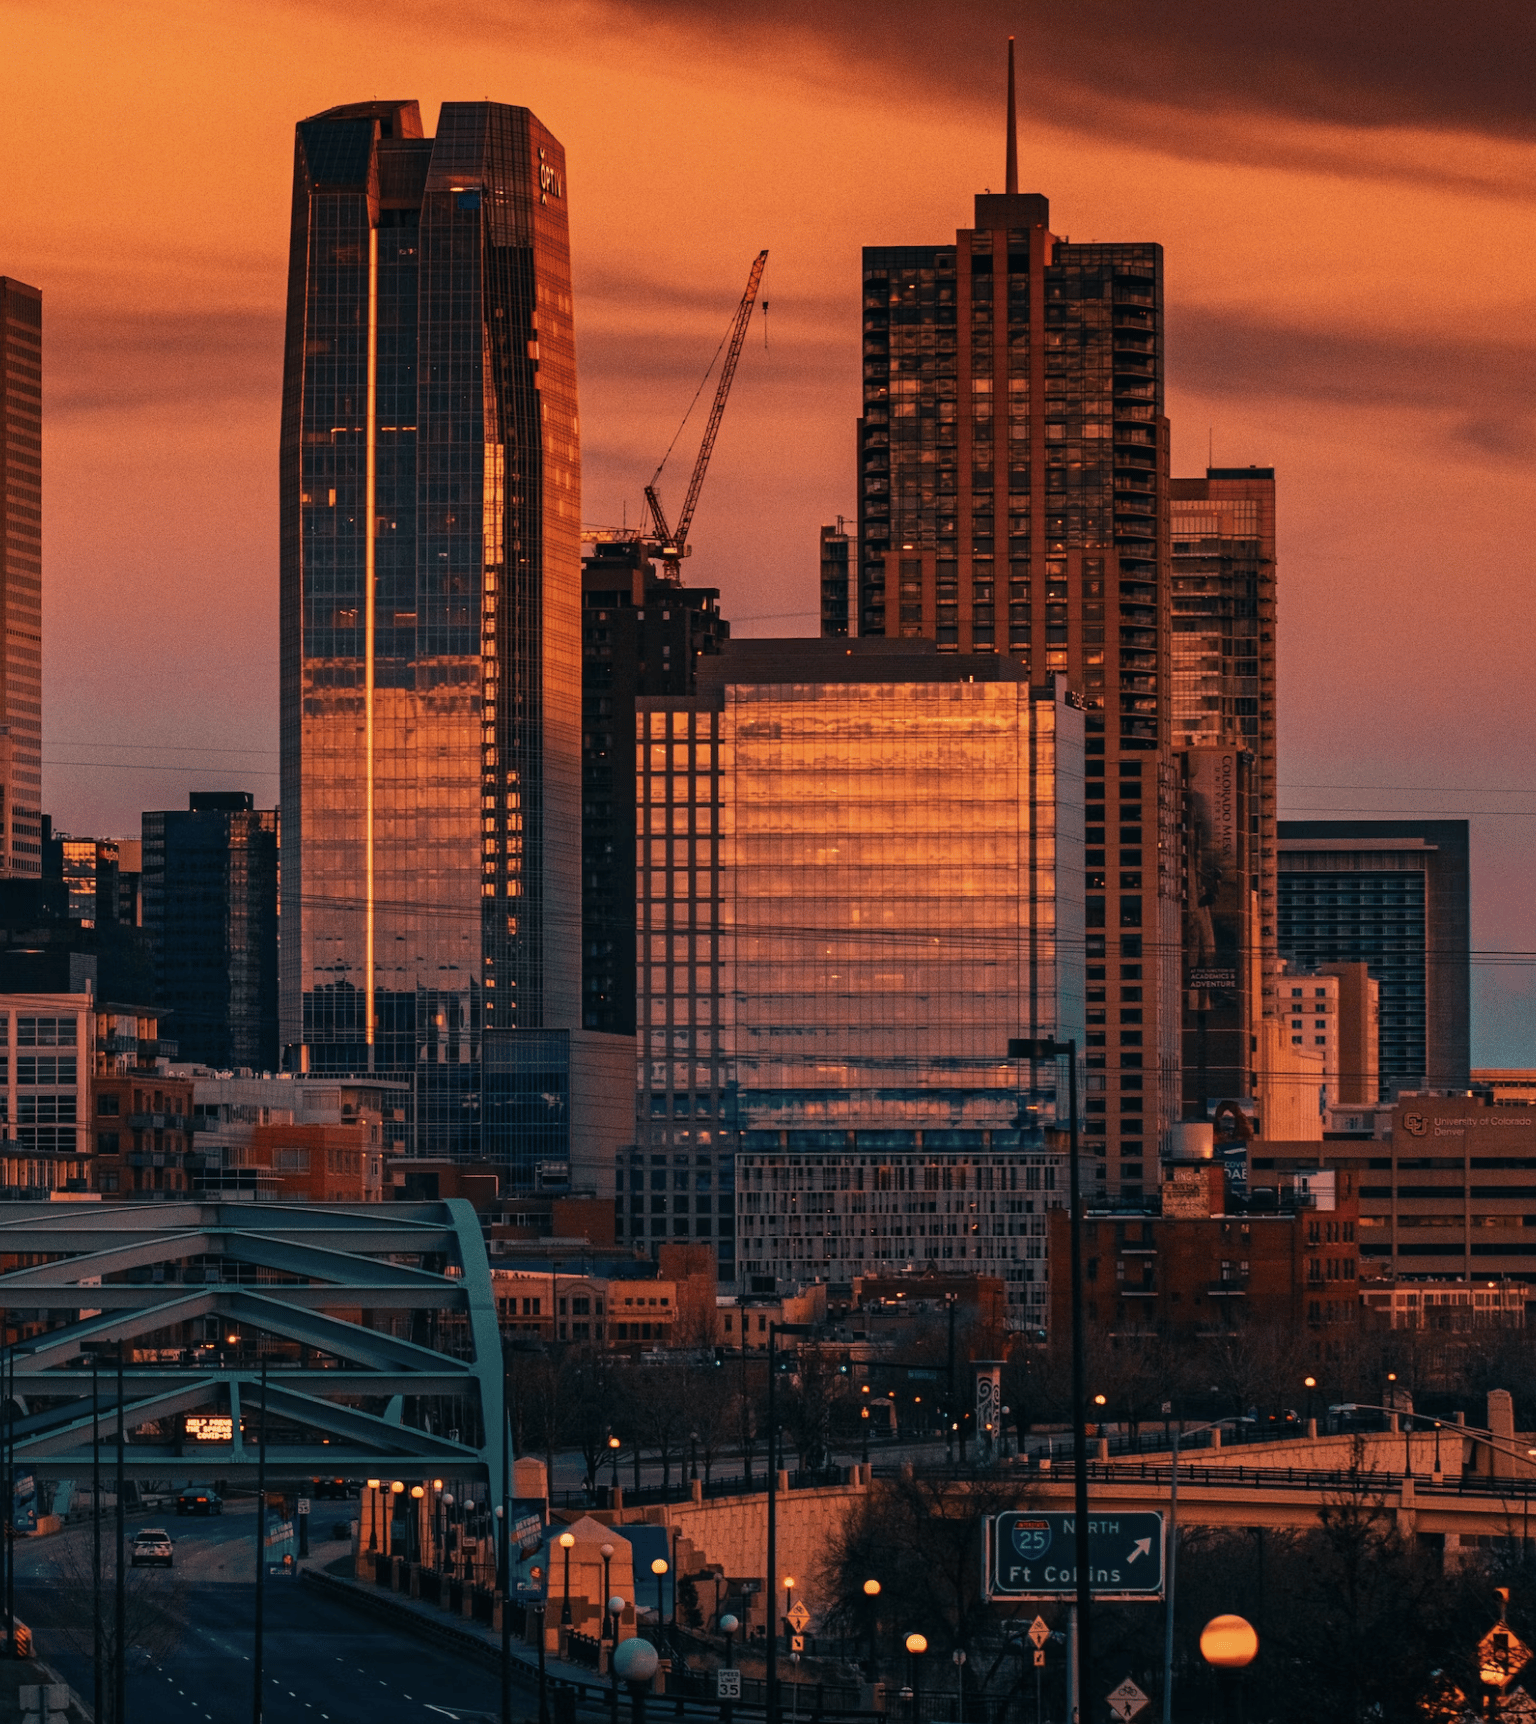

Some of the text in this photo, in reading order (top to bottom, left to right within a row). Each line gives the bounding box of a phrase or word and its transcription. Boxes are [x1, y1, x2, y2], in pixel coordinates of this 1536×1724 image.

[541, 163, 561, 198] OPTIV
[1221, 755, 1233, 856] COLORADO MESA
[1434, 1117, 1532, 1127] University of Colorado
[1434, 1128, 1464, 1136] Denver
[187, 1418, 207, 1426] HELP
[1063, 1520, 1120, 1534] NRTH
[1019, 1531, 1045, 1550] 25
[1009, 1566, 1121, 1582] Ft Colins
[720, 1684, 738, 1695] 35
